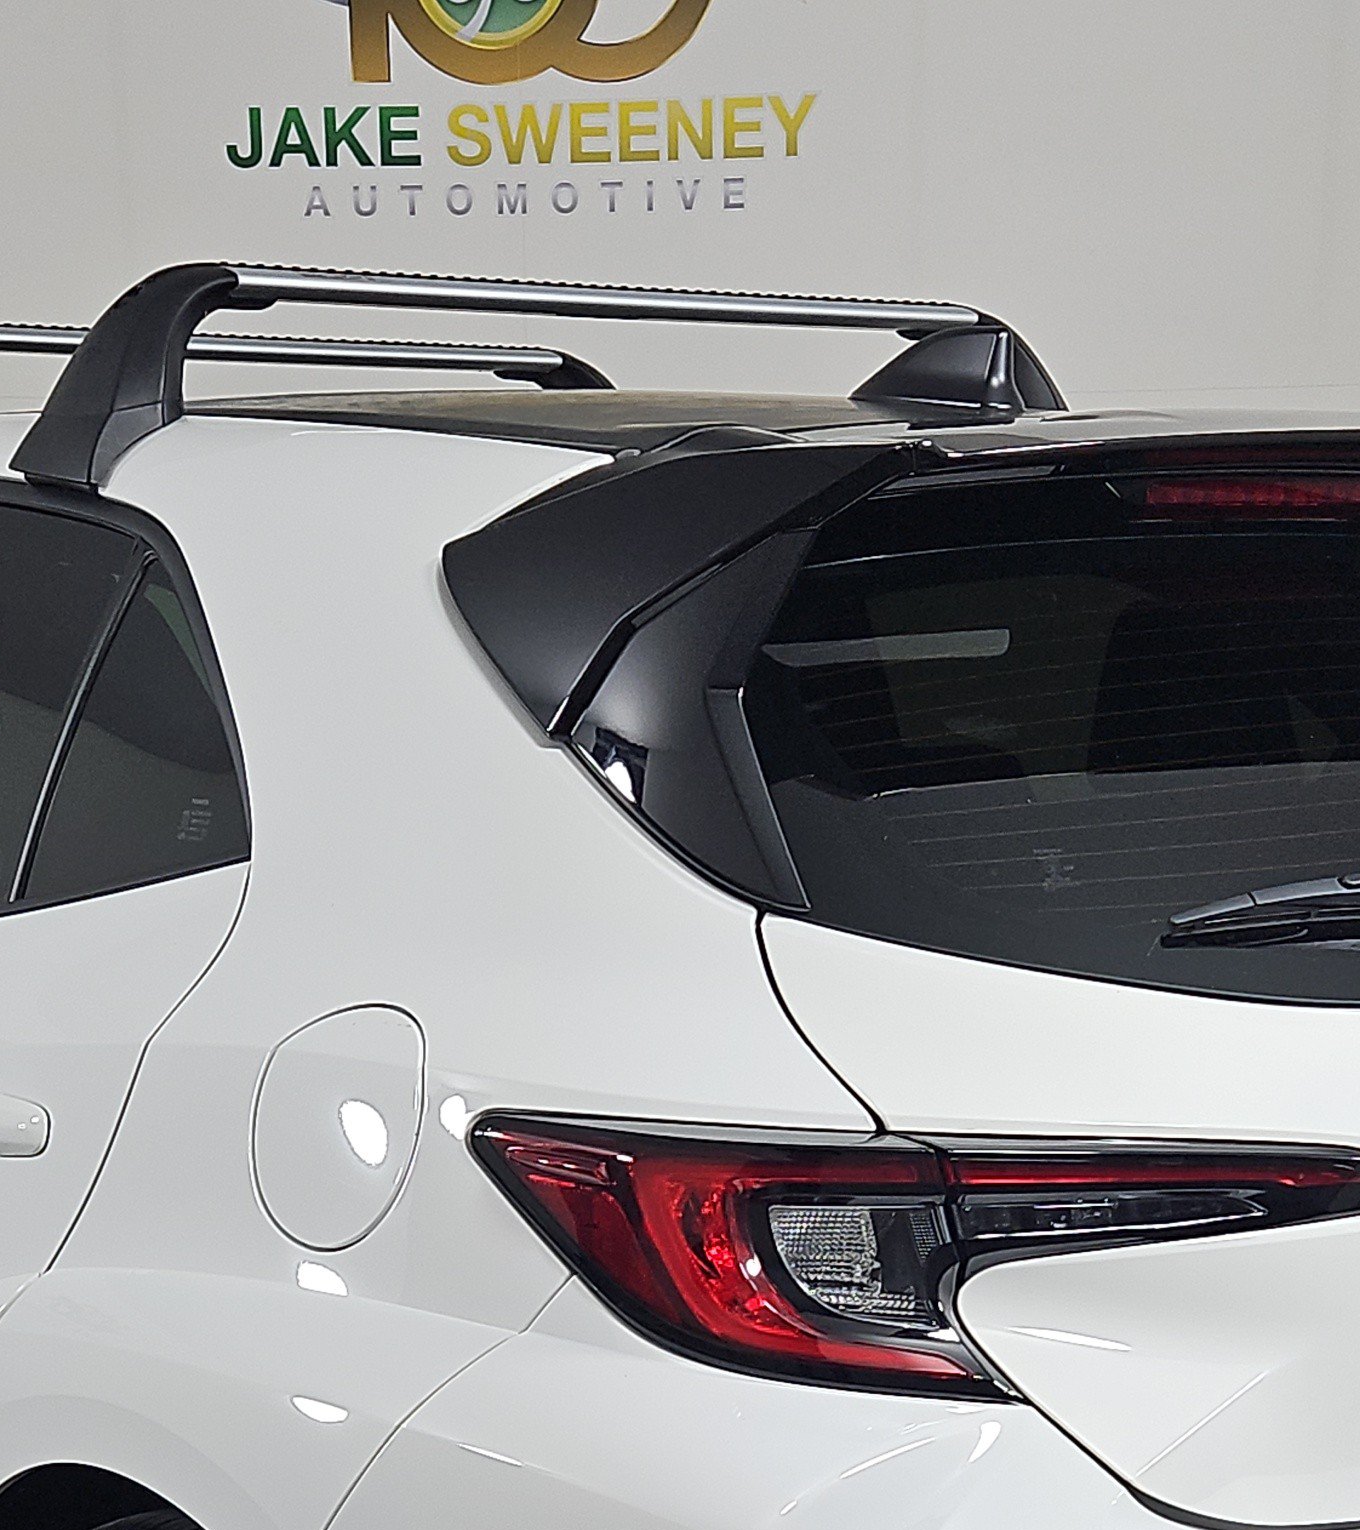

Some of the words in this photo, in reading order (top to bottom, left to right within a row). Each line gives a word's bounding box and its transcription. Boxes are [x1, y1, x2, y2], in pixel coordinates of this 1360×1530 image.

[226, 106, 422, 168] JAKE
[446, 95, 816, 166] SWEENEY
[304, 177, 745, 216] AUTOMOTIVE
